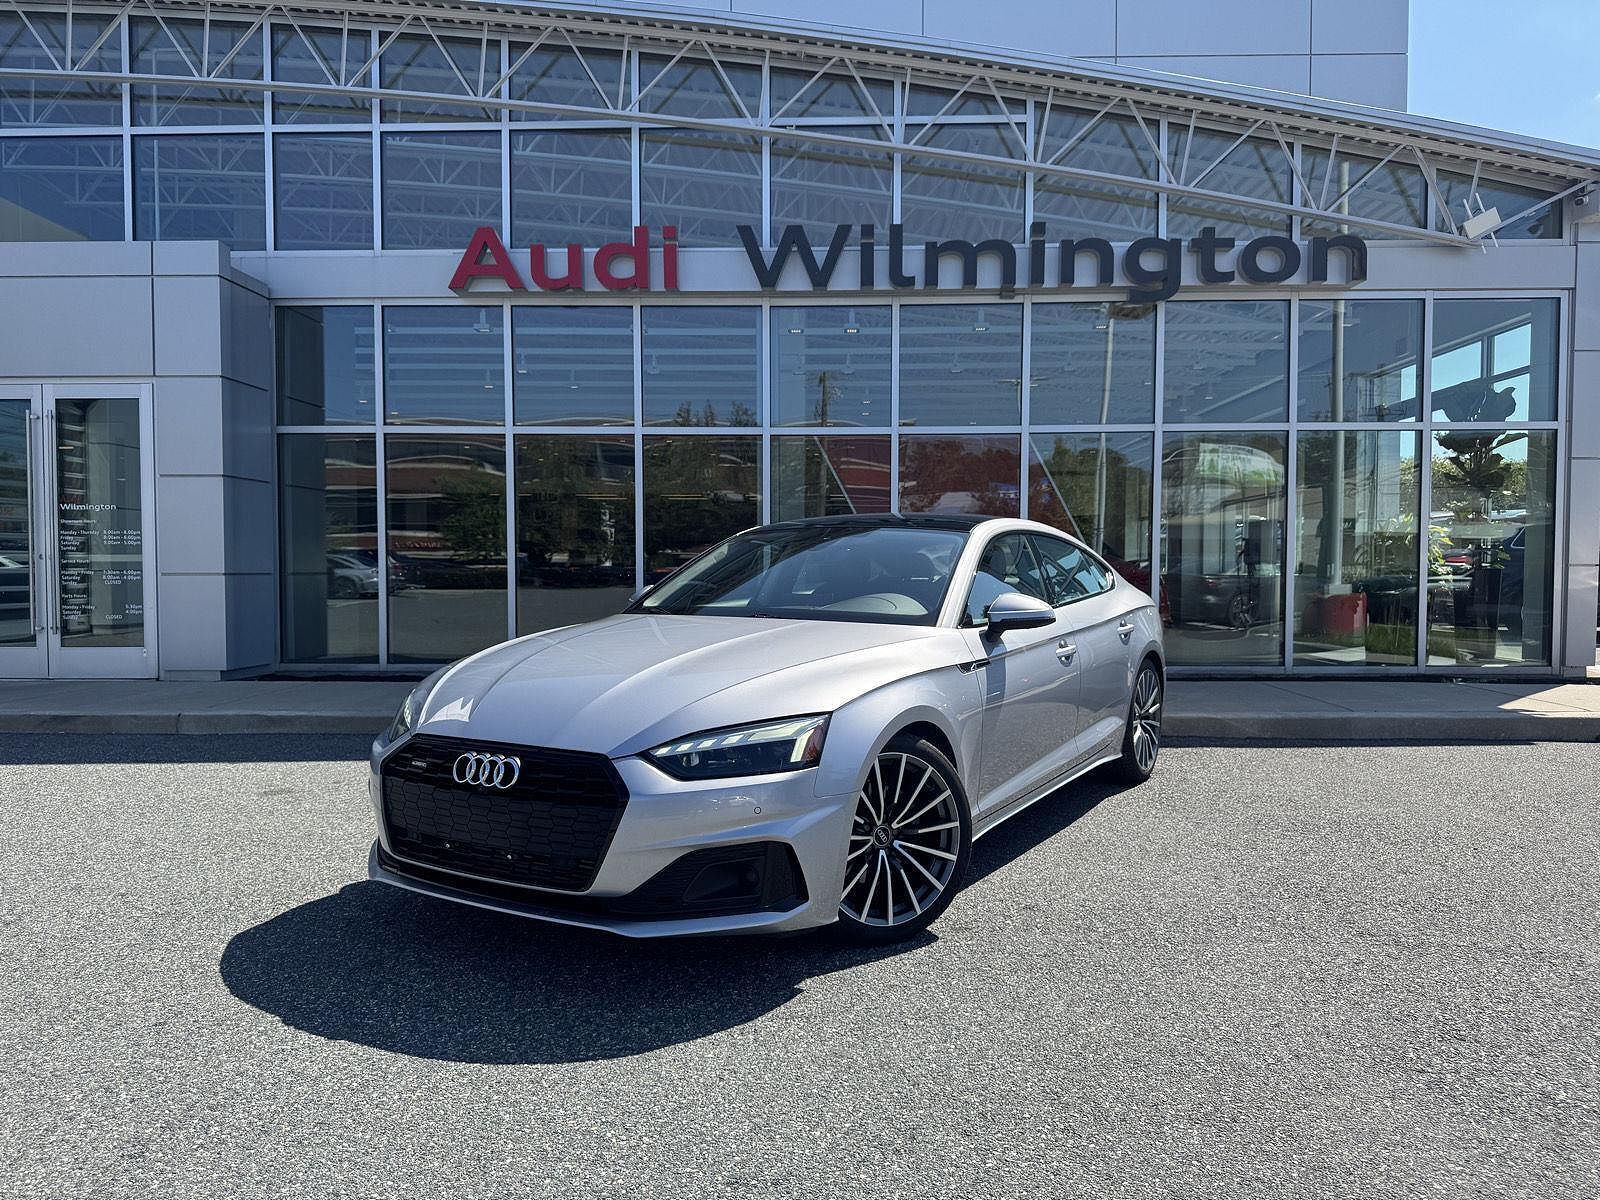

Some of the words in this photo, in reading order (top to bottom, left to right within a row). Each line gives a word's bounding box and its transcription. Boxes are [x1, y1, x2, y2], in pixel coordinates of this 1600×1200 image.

[448, 224, 677, 291] Audi
[736, 221, 1368, 301] Wilmington
[60, 503, 117, 512] Wilmington
